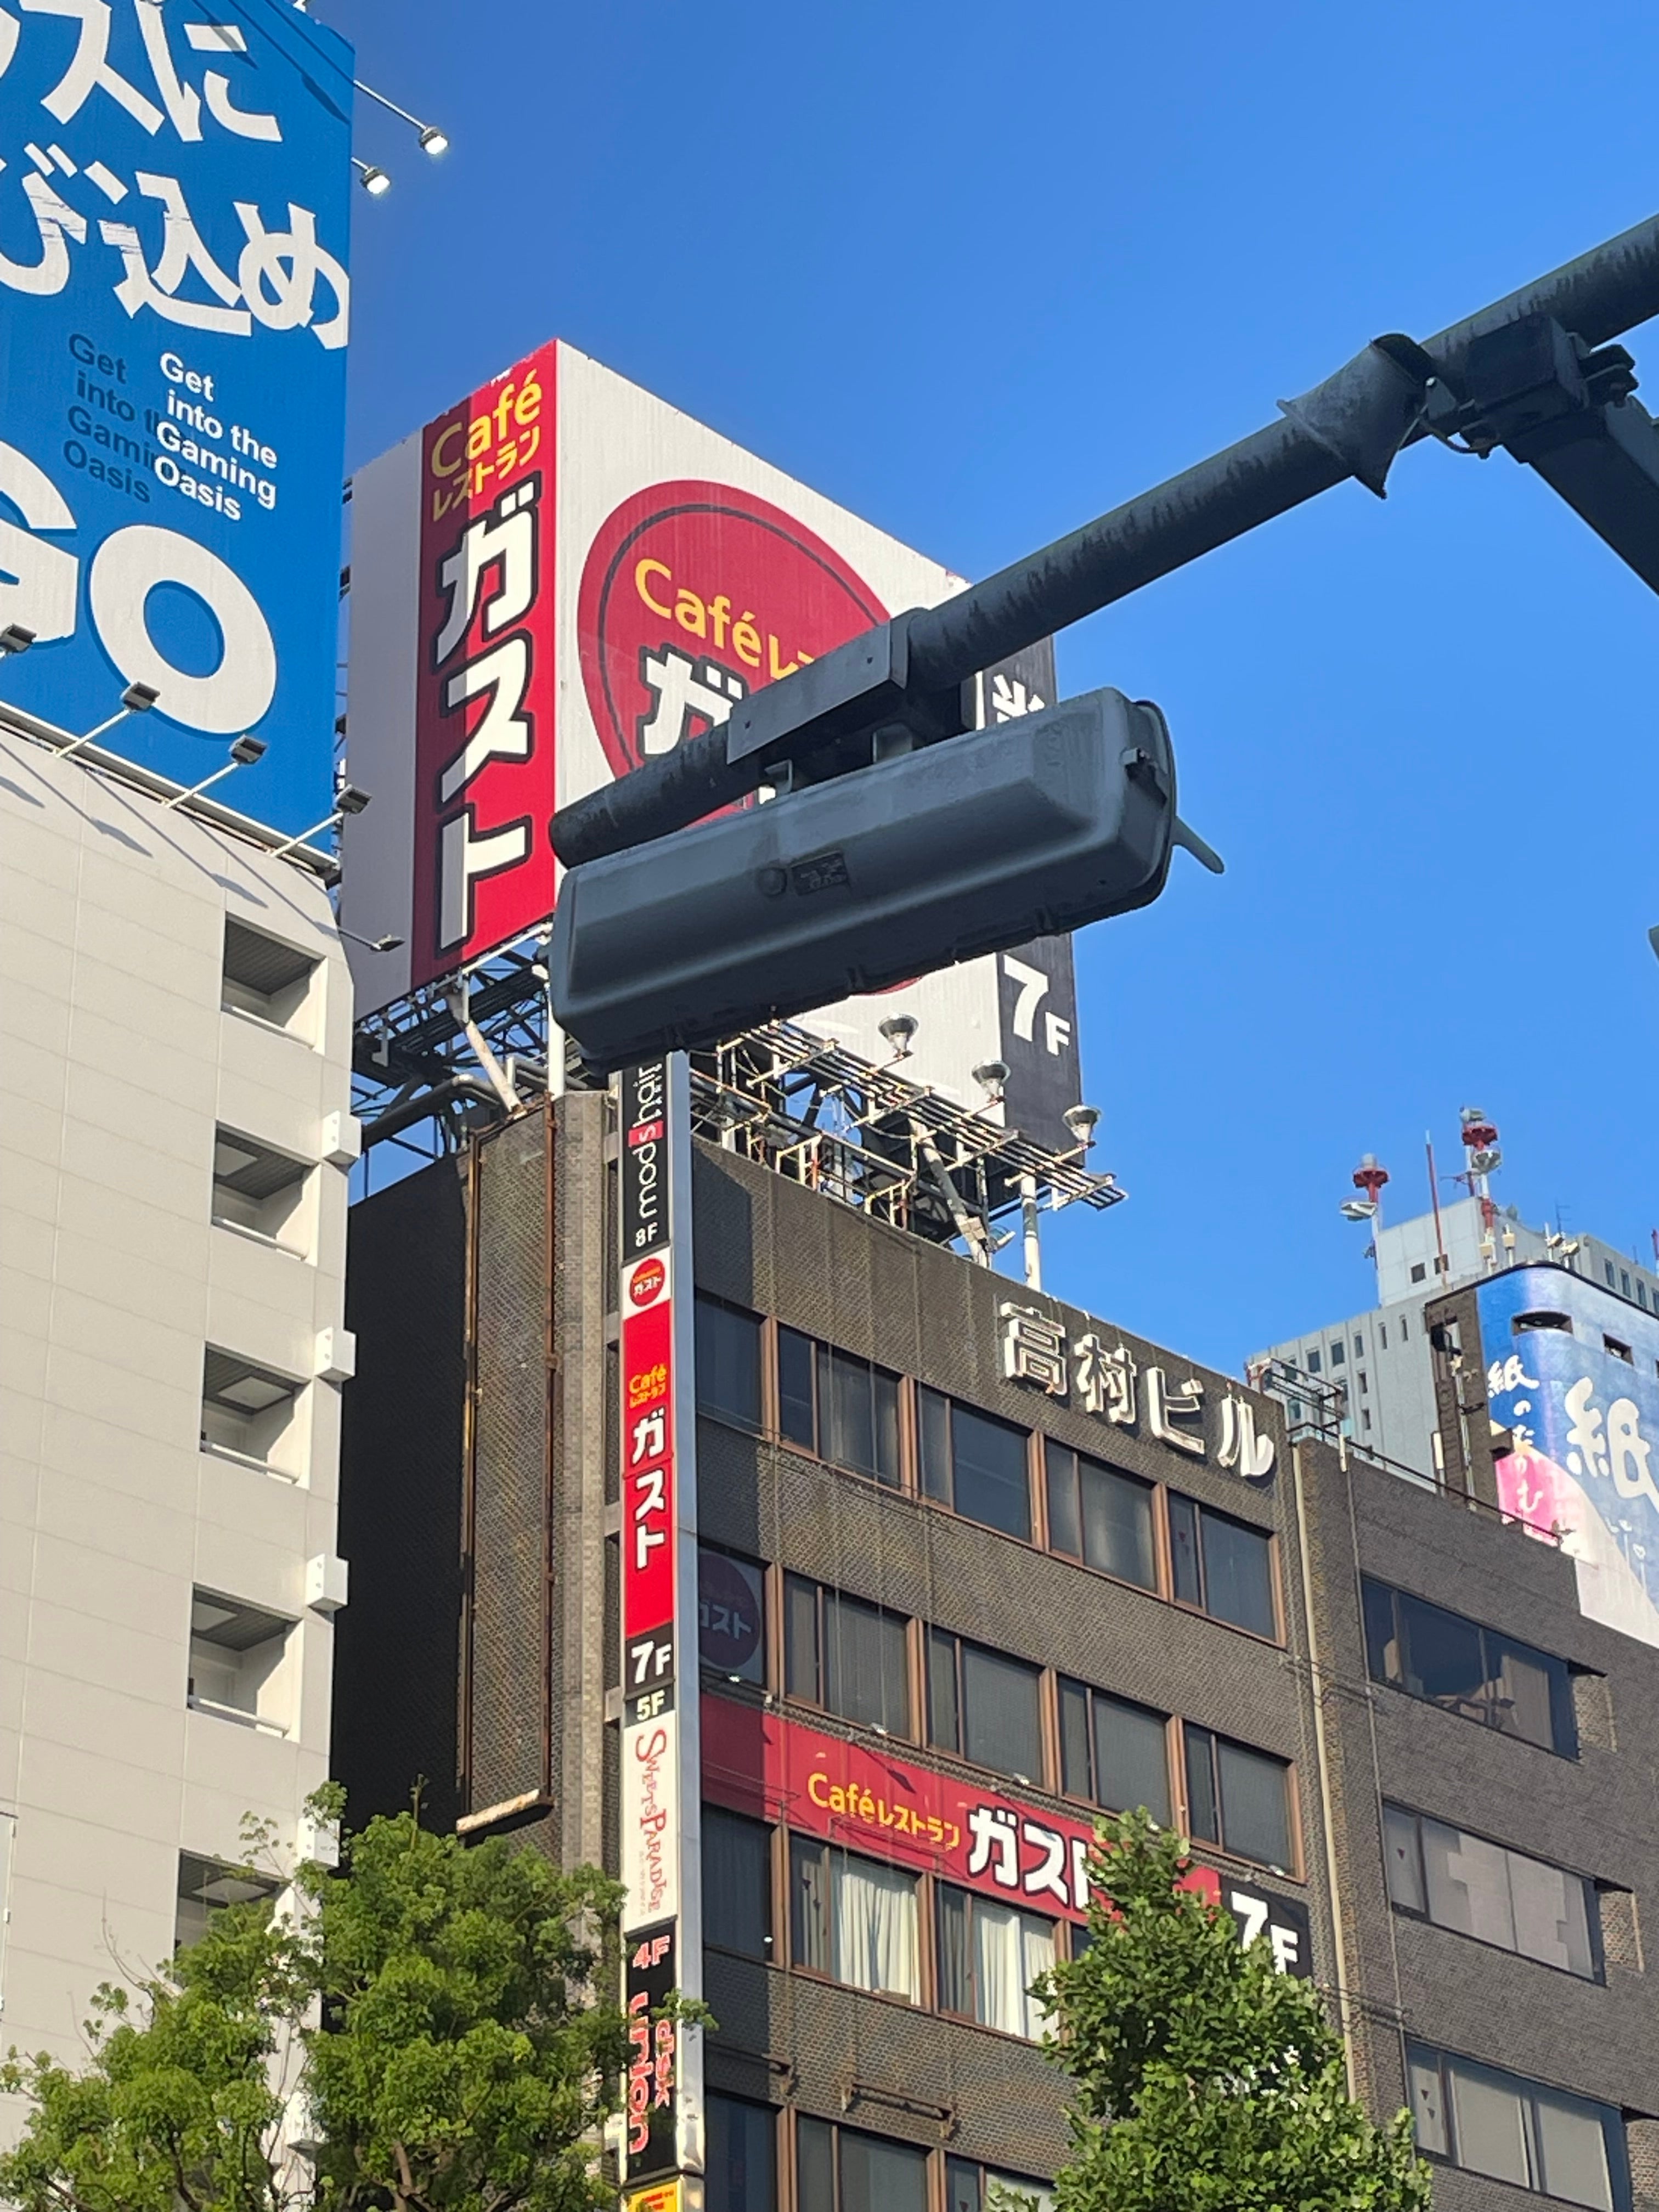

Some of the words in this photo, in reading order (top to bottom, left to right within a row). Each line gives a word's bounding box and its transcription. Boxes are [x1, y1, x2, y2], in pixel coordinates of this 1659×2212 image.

[0, 0, 283, 142] スに
[160, 352, 215, 402] Get
[156, 421, 276, 510] Gaming
[167, 388, 223, 439] into
[230, 425, 278, 469] the
[432, 368, 542, 478] Café
[154, 455, 241, 521] Oasis
[433, 425, 540, 522] レストラン
[437, 478, 537, 952] ガスト
[1003, 953, 1071, 1057] 7F
[635, 1222, 658, 1248] 8F
[1000, 1301, 1274, 1477] 高村ビル
[632, 1407, 665, 1570] ガスト
[631, 1640, 672, 1684] 7F
[636, 1689, 665, 1722] 5F
[632, 1934, 671, 1970] 4F
[1231, 1891, 1299, 1976] 7F
